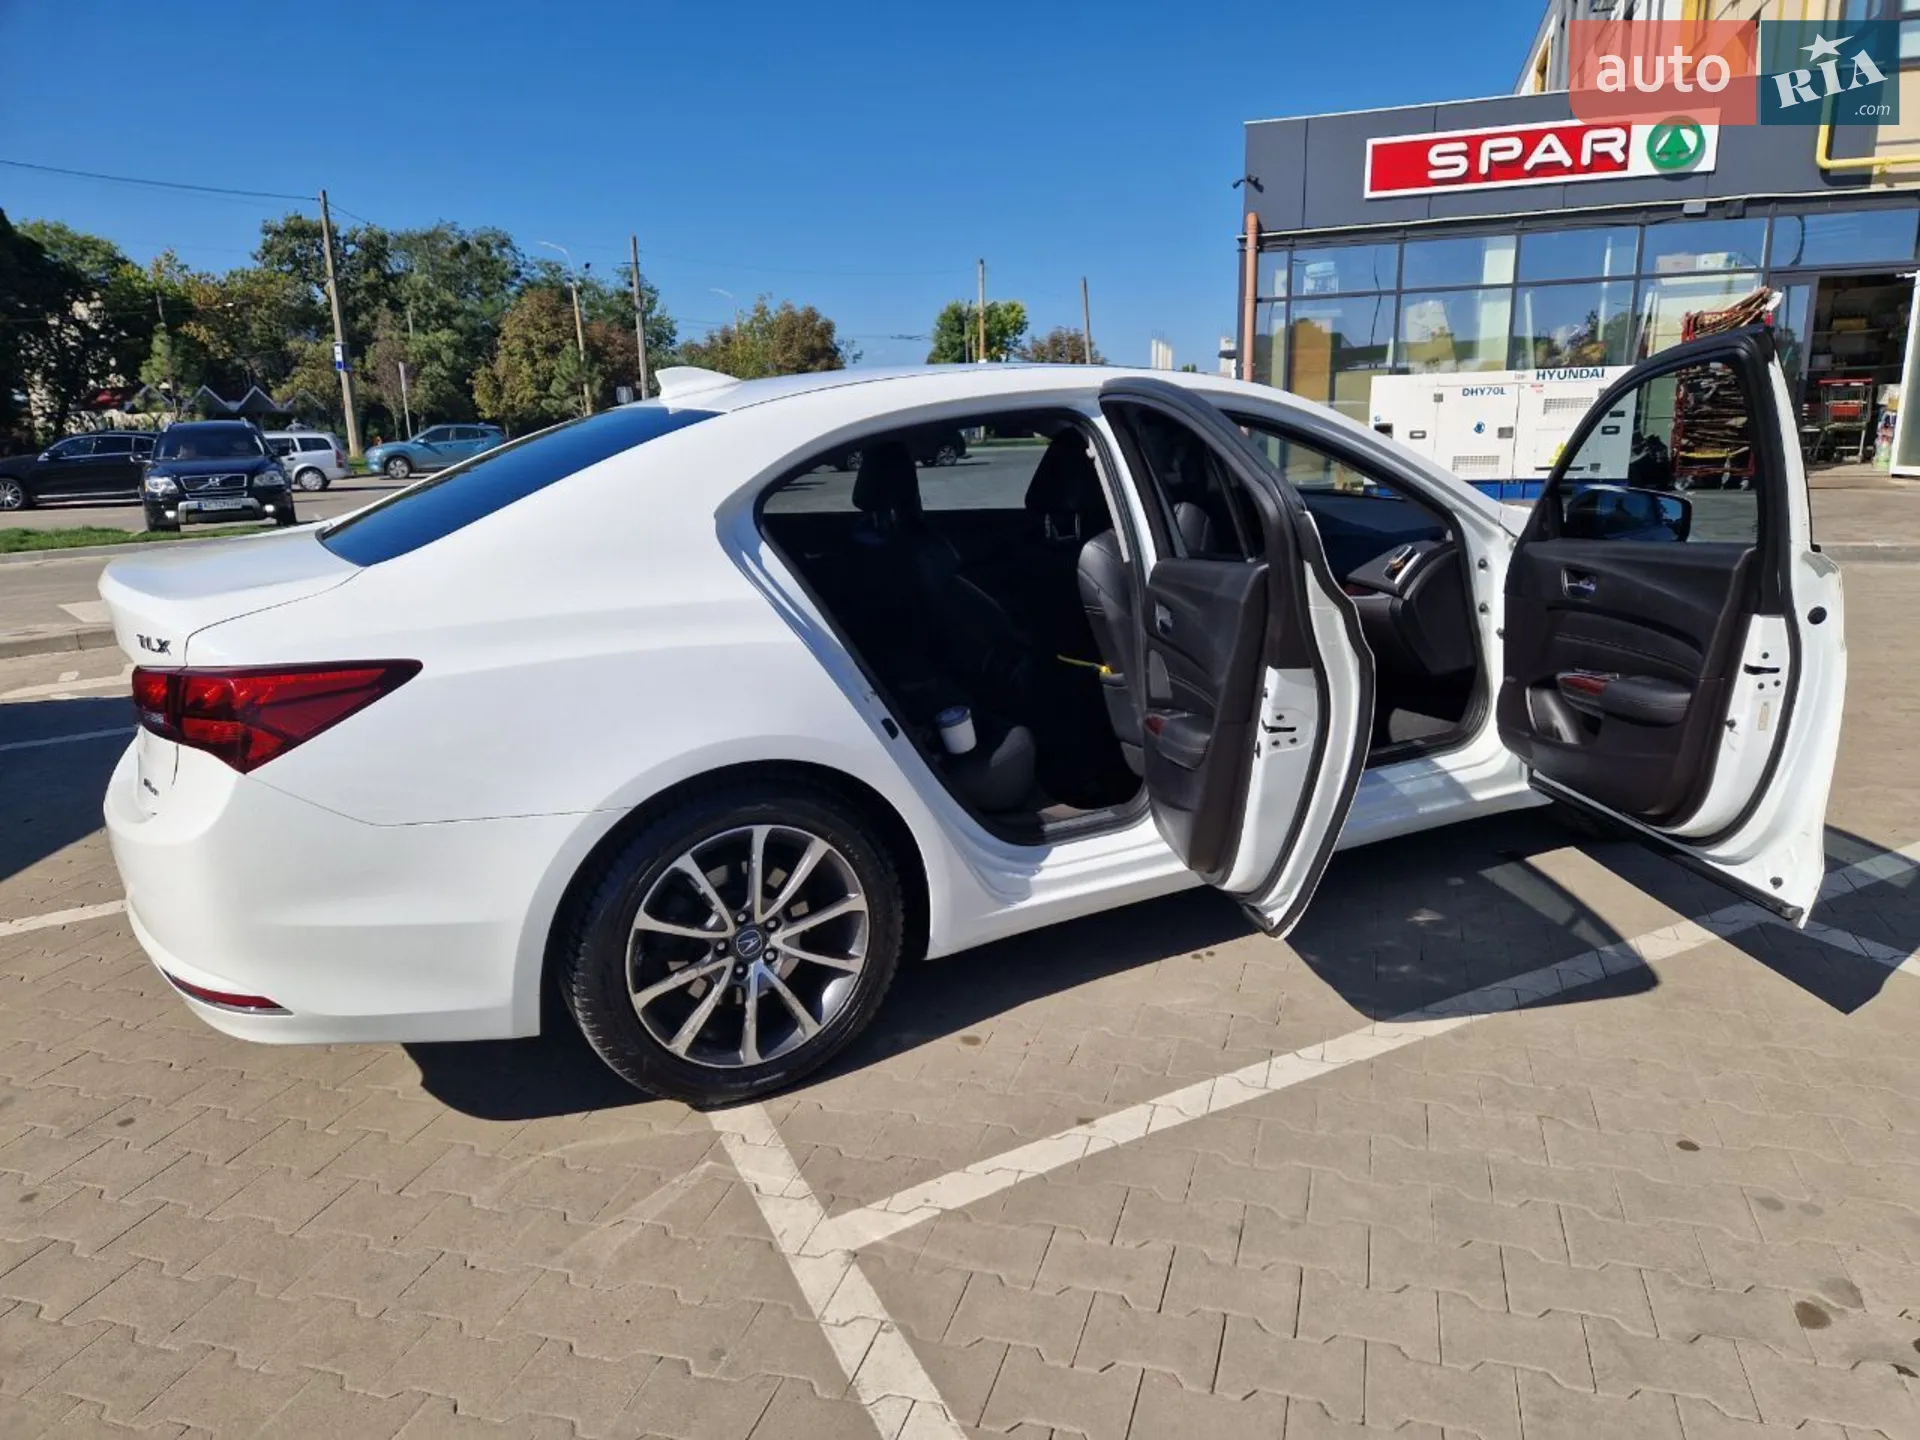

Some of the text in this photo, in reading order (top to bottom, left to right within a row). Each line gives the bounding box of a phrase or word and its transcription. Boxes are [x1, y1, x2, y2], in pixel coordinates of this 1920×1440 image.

[1427, 127, 1627, 179] SPAR
[1536, 368, 1605, 380] HYUNDAI
[1462, 387, 1506, 397] DHY70L
[136, 634, 171, 656] TLX
